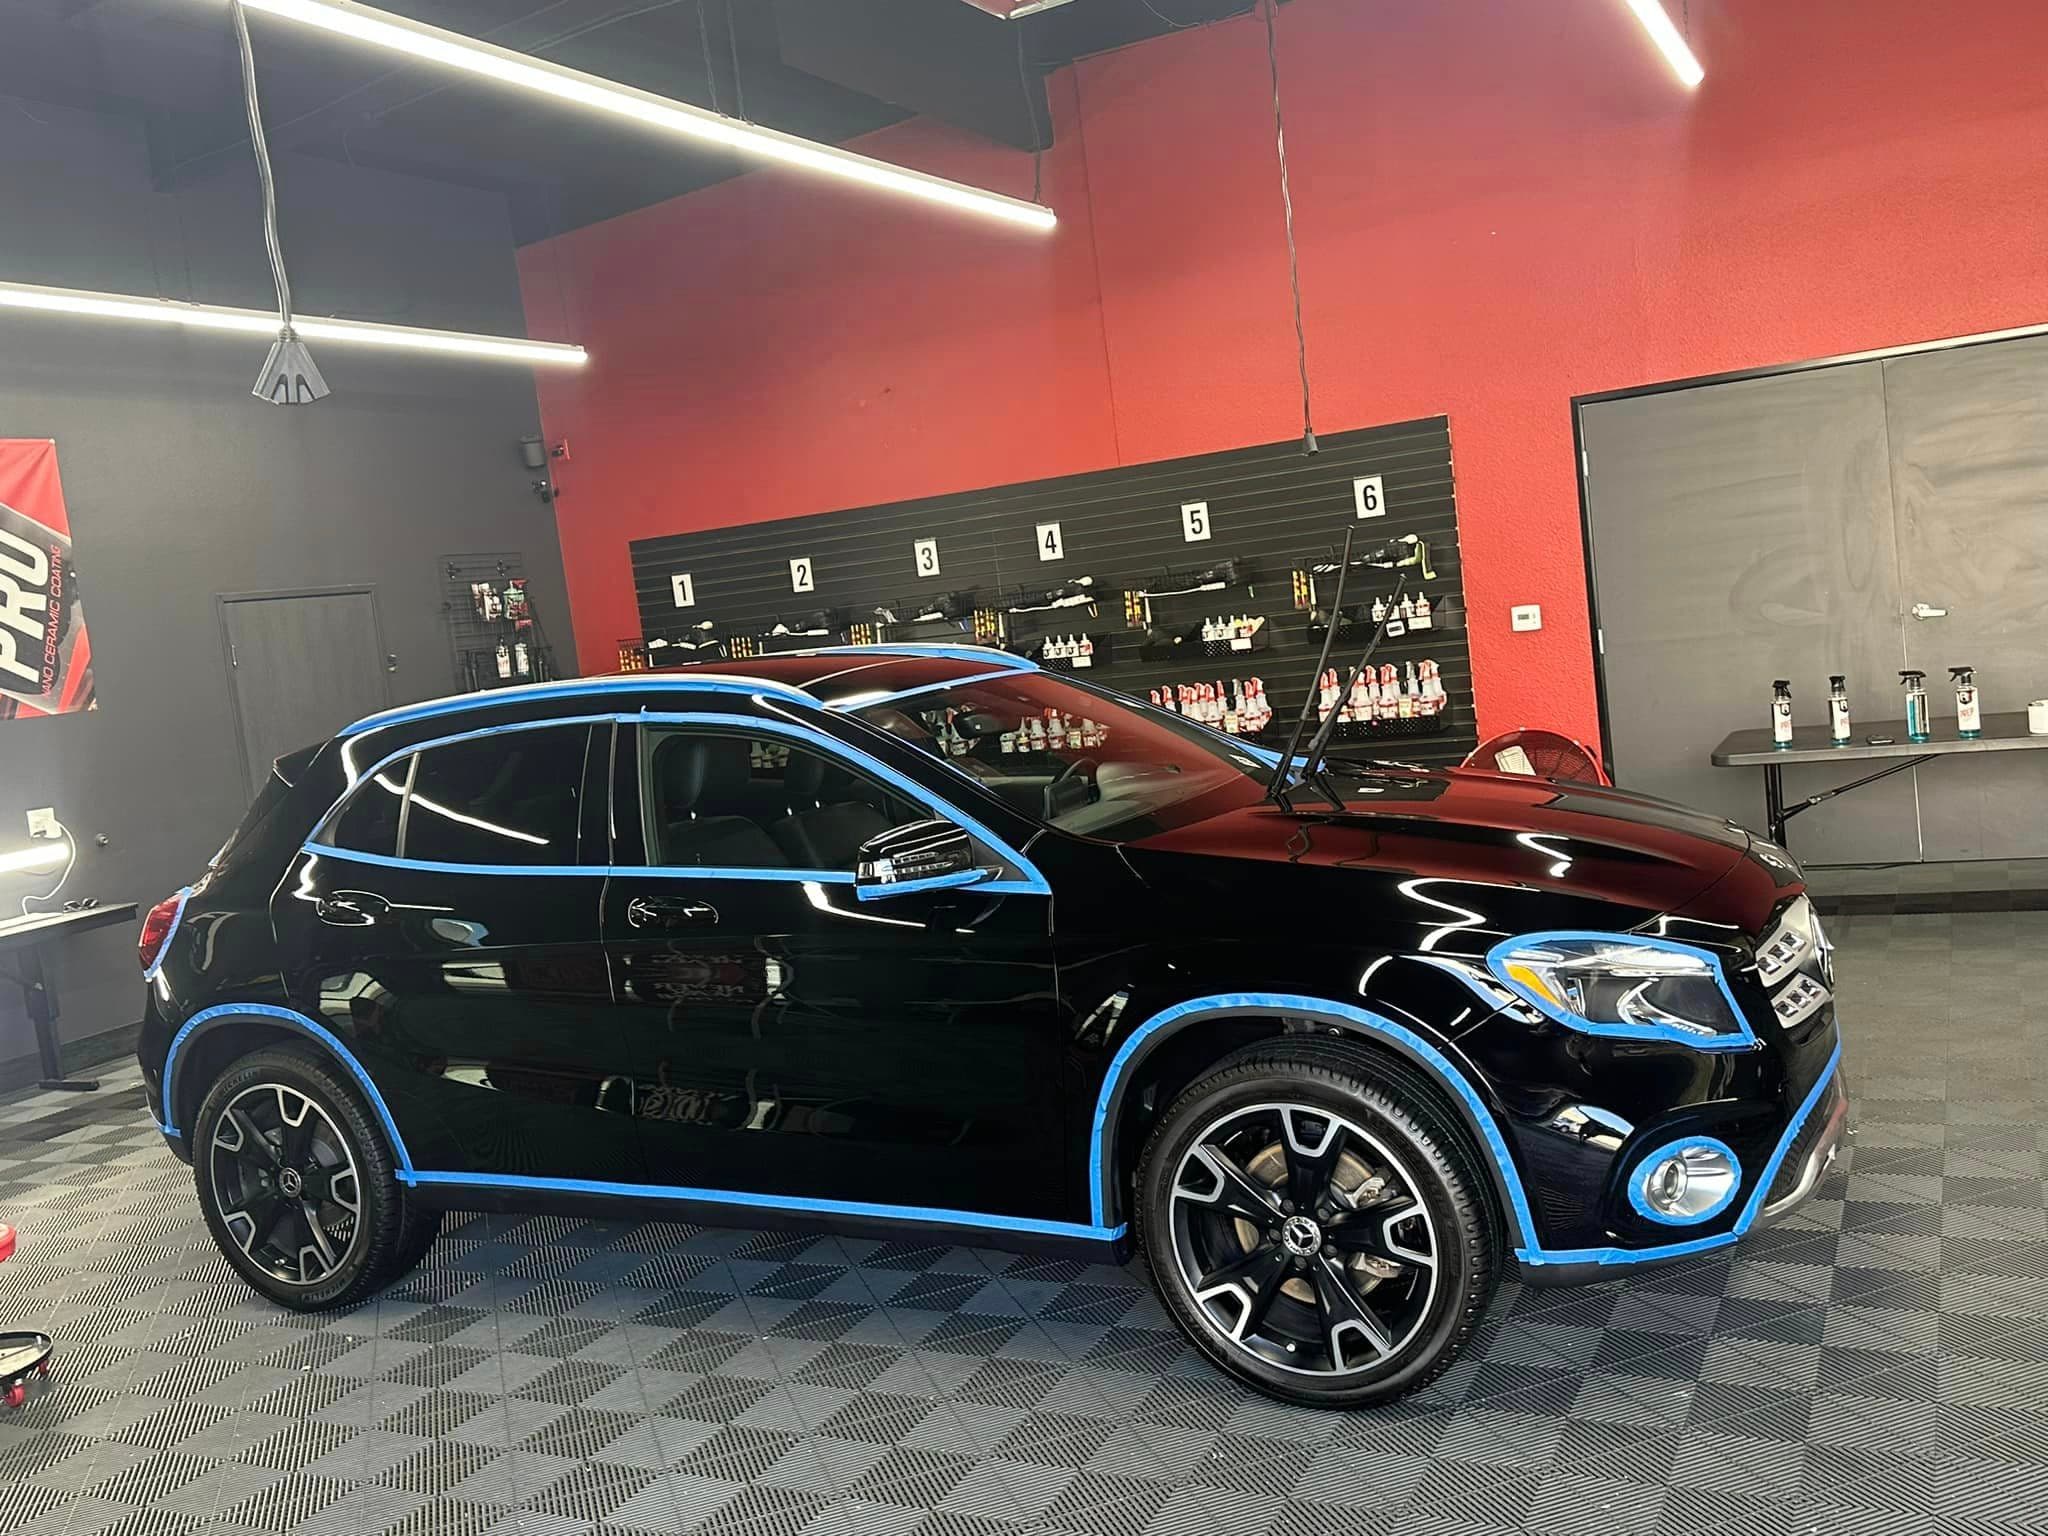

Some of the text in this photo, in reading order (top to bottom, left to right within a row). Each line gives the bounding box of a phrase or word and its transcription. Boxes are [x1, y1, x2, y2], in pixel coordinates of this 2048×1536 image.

[1363, 485, 1377, 510] 6
[1190, 510, 1203, 534] 5
[1045, 529, 1058, 553] 4
[50, 544, 62, 597] COATING
[921, 547, 933, 570] 3
[796, 565, 809, 587] 2
[678, 581, 687, 601] 1
[44, 600, 61, 664] CERAMIC
